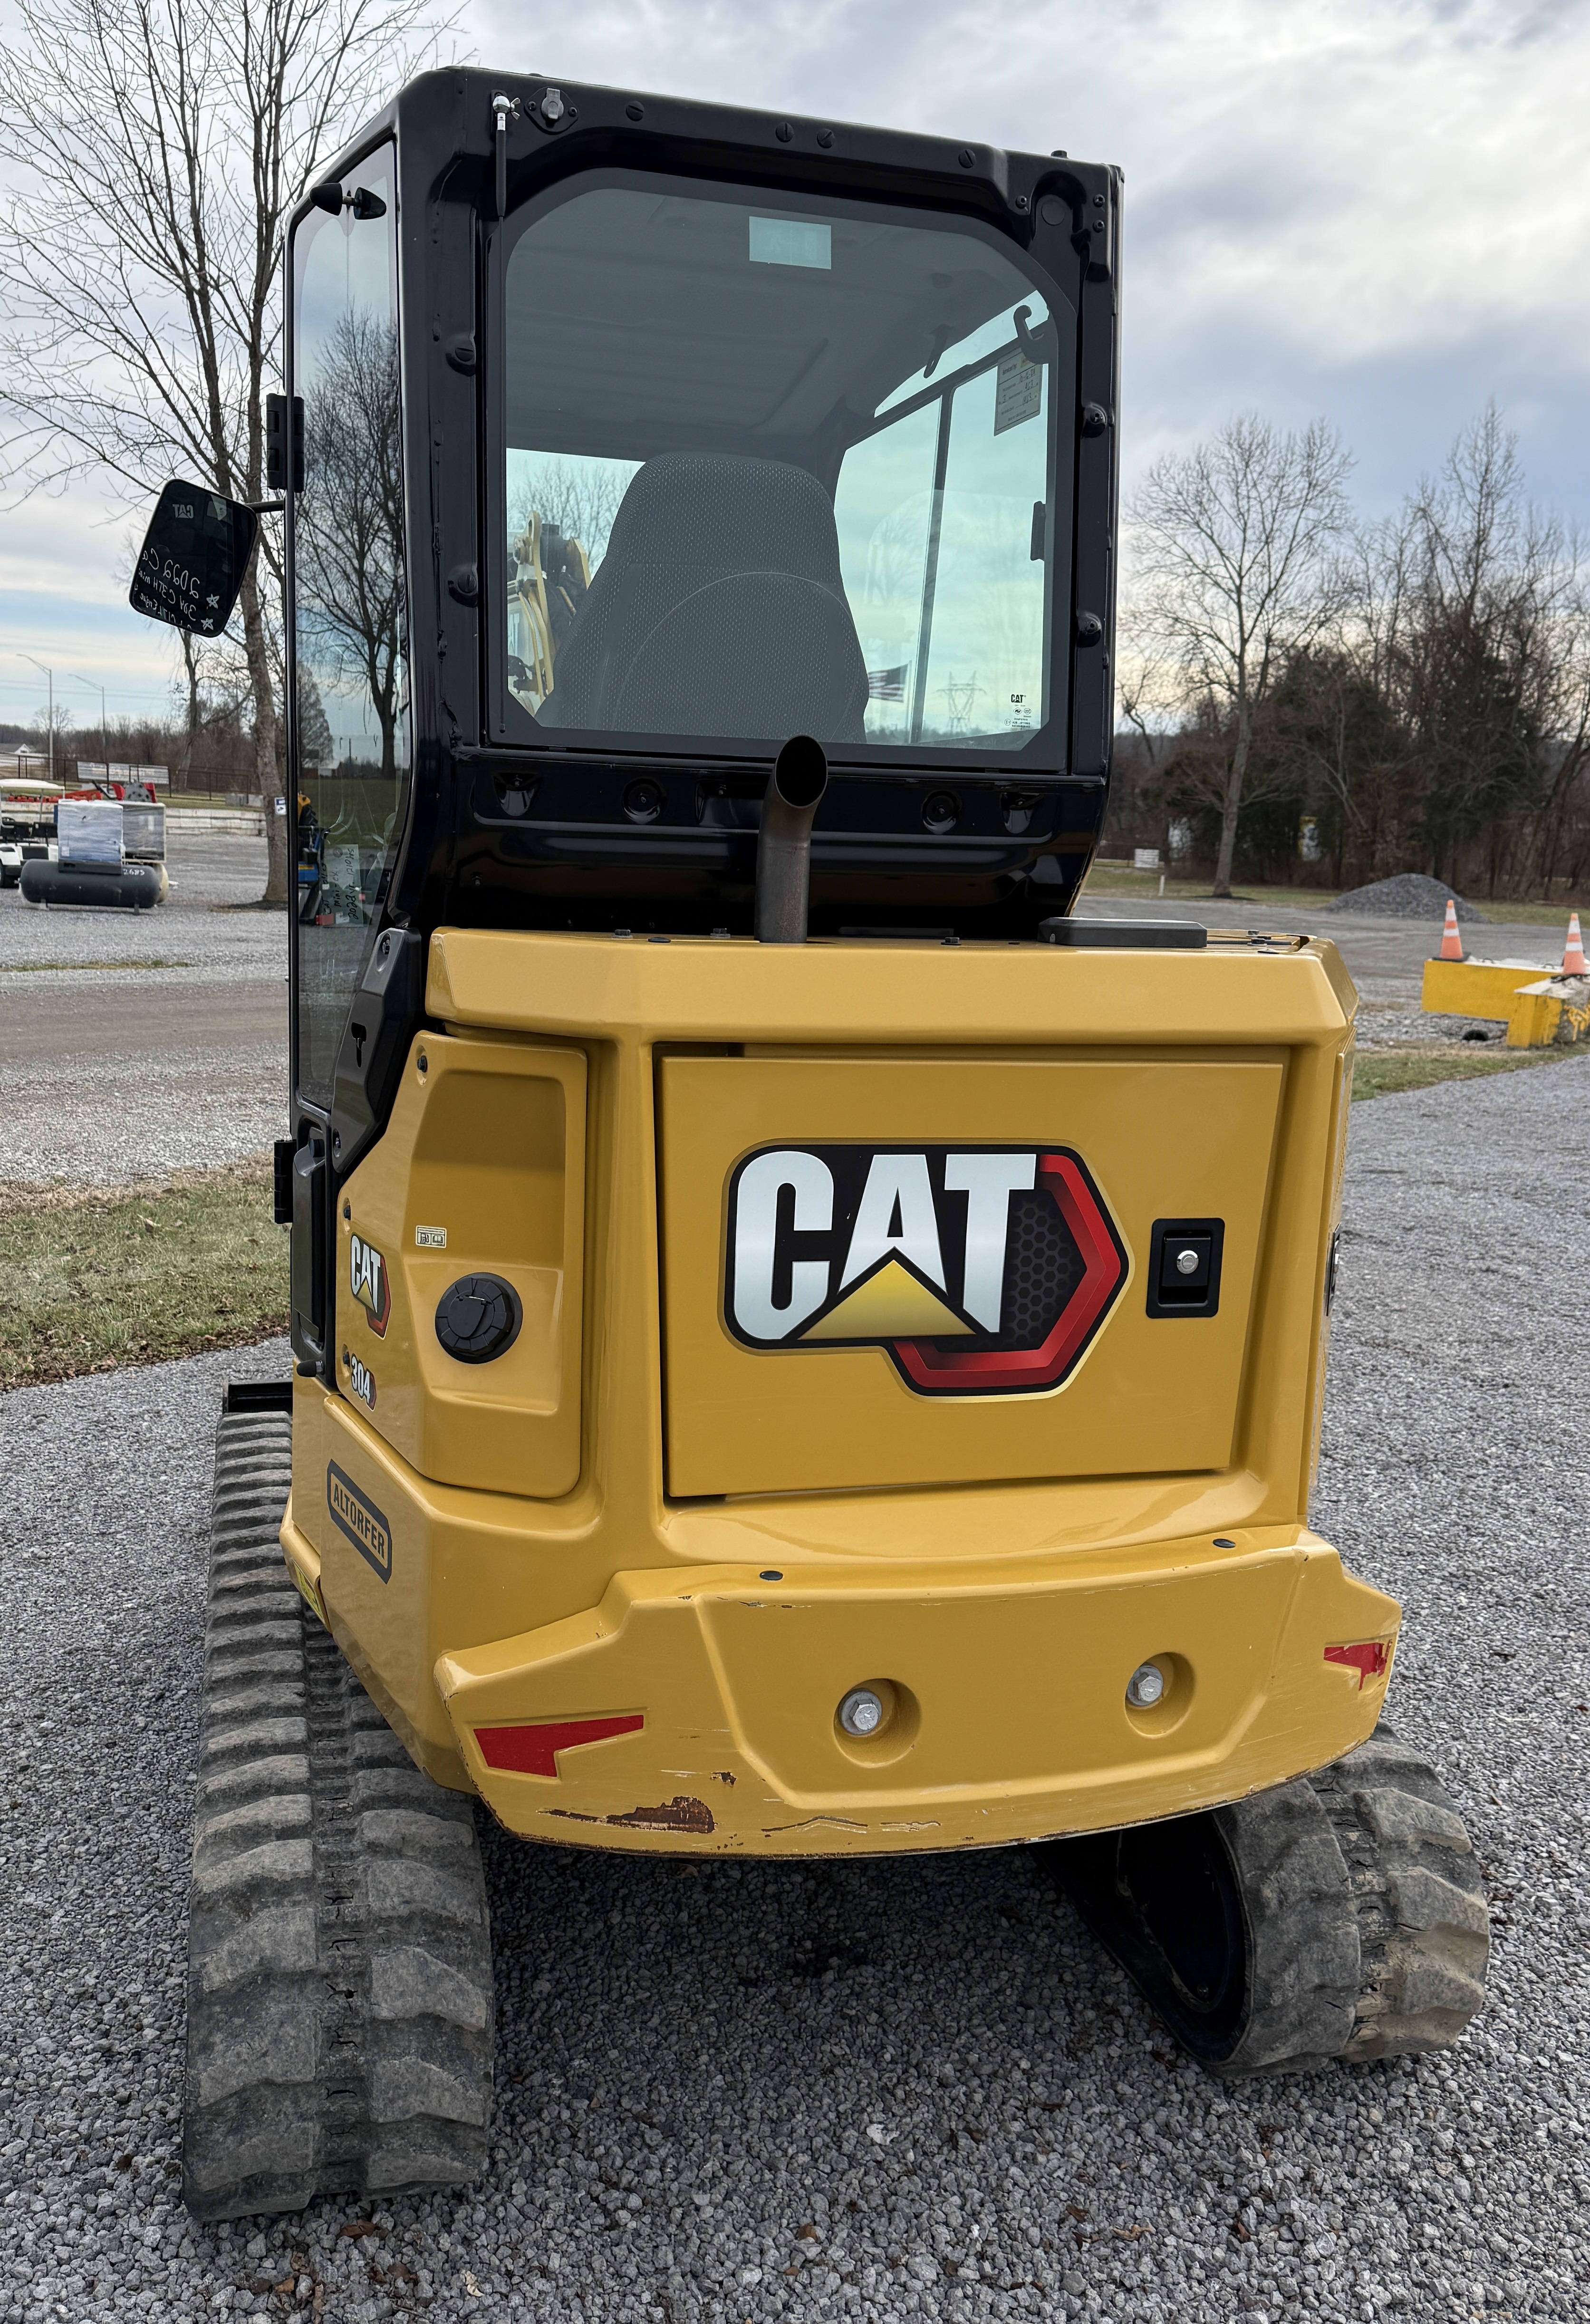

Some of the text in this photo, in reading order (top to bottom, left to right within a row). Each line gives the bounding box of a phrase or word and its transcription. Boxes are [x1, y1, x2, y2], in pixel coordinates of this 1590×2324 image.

[1011, 694, 1024, 703] CAT
[346, 895, 358, 919] 2022
[351, 1235, 380, 1313] CAT
[733, 1150, 1037, 1340] CAT
[351, 1356, 370, 1404] 304
[334, 1483, 385, 1560] ALTORFER
